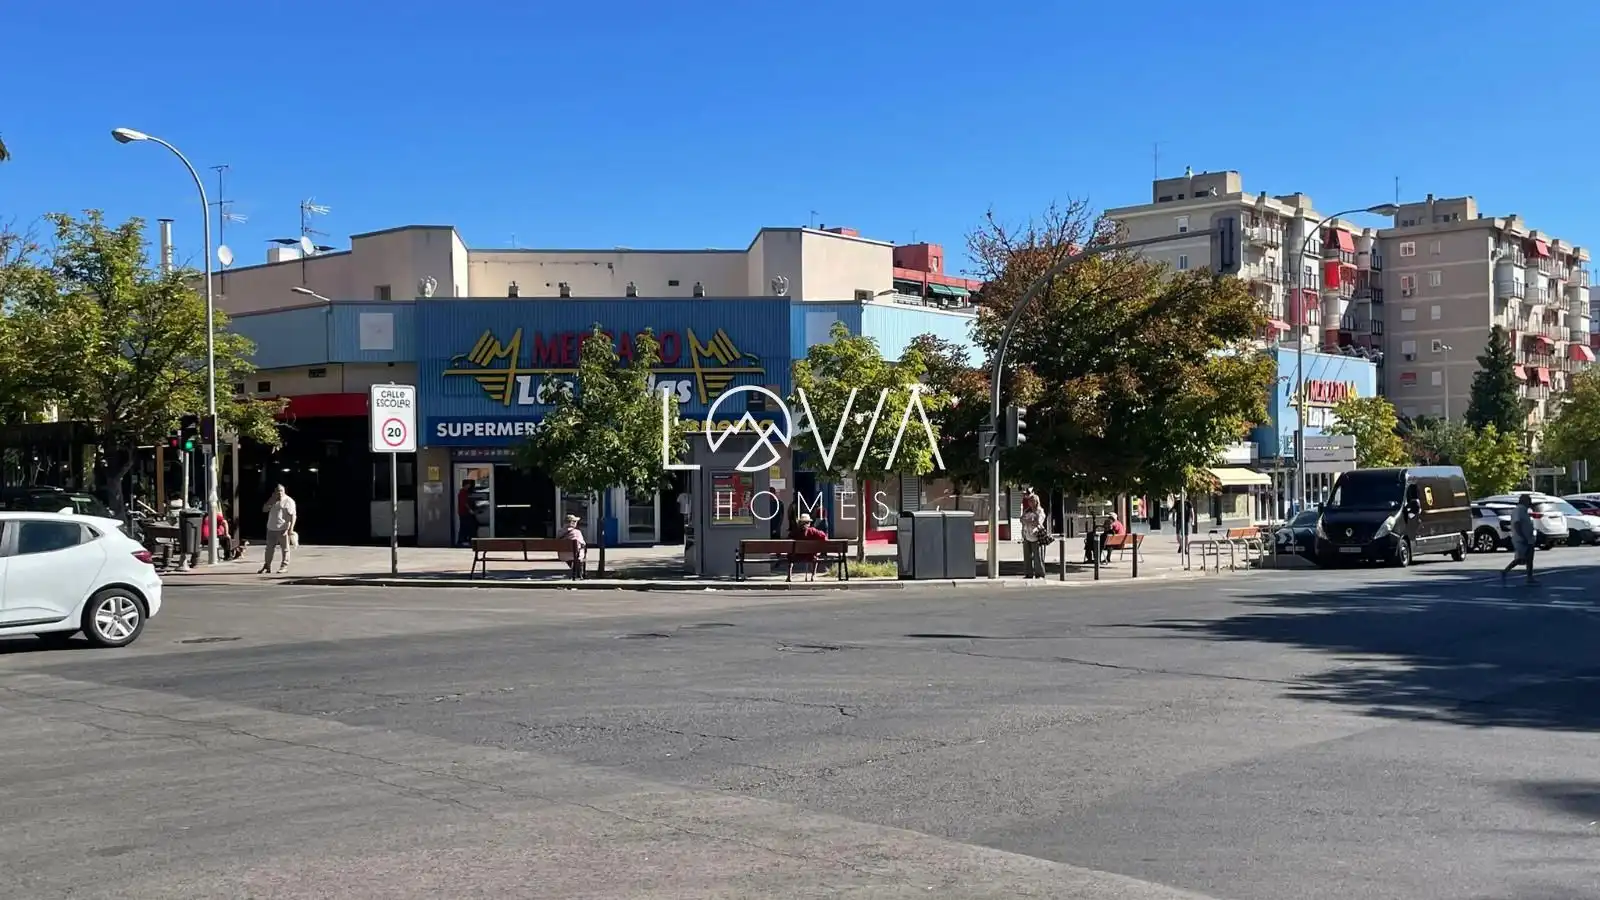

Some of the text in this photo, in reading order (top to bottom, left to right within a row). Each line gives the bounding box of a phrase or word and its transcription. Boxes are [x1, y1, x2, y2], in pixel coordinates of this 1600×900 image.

[531, 330, 682, 365] MEAO
[376, 398, 410, 408] ESCOLAR
[387, 427, 402, 437] 20
[437, 421, 549, 438] SUPERMER
